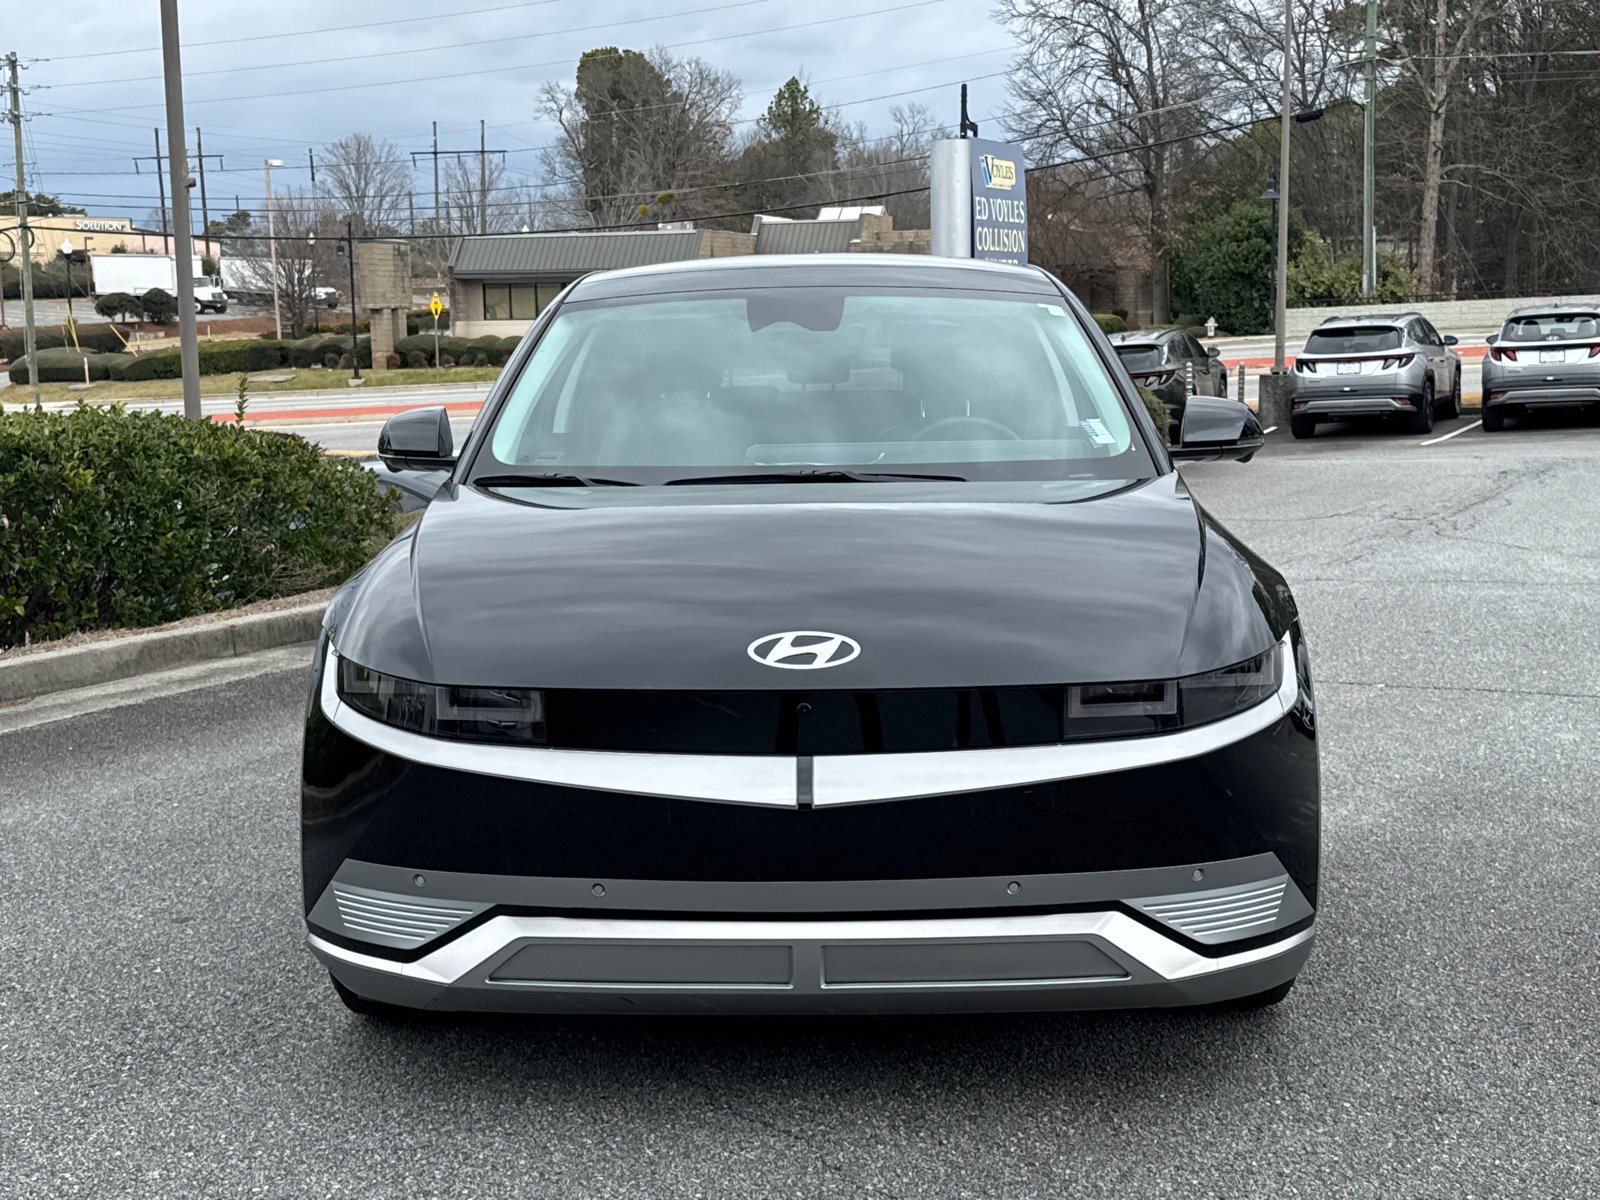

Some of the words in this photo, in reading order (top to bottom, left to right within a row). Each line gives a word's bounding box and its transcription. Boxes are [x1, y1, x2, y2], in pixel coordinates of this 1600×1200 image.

[975, 197, 989, 220] ED
[990, 199, 1025, 224] VOYLES
[976, 227, 1026, 253] COLLISION
